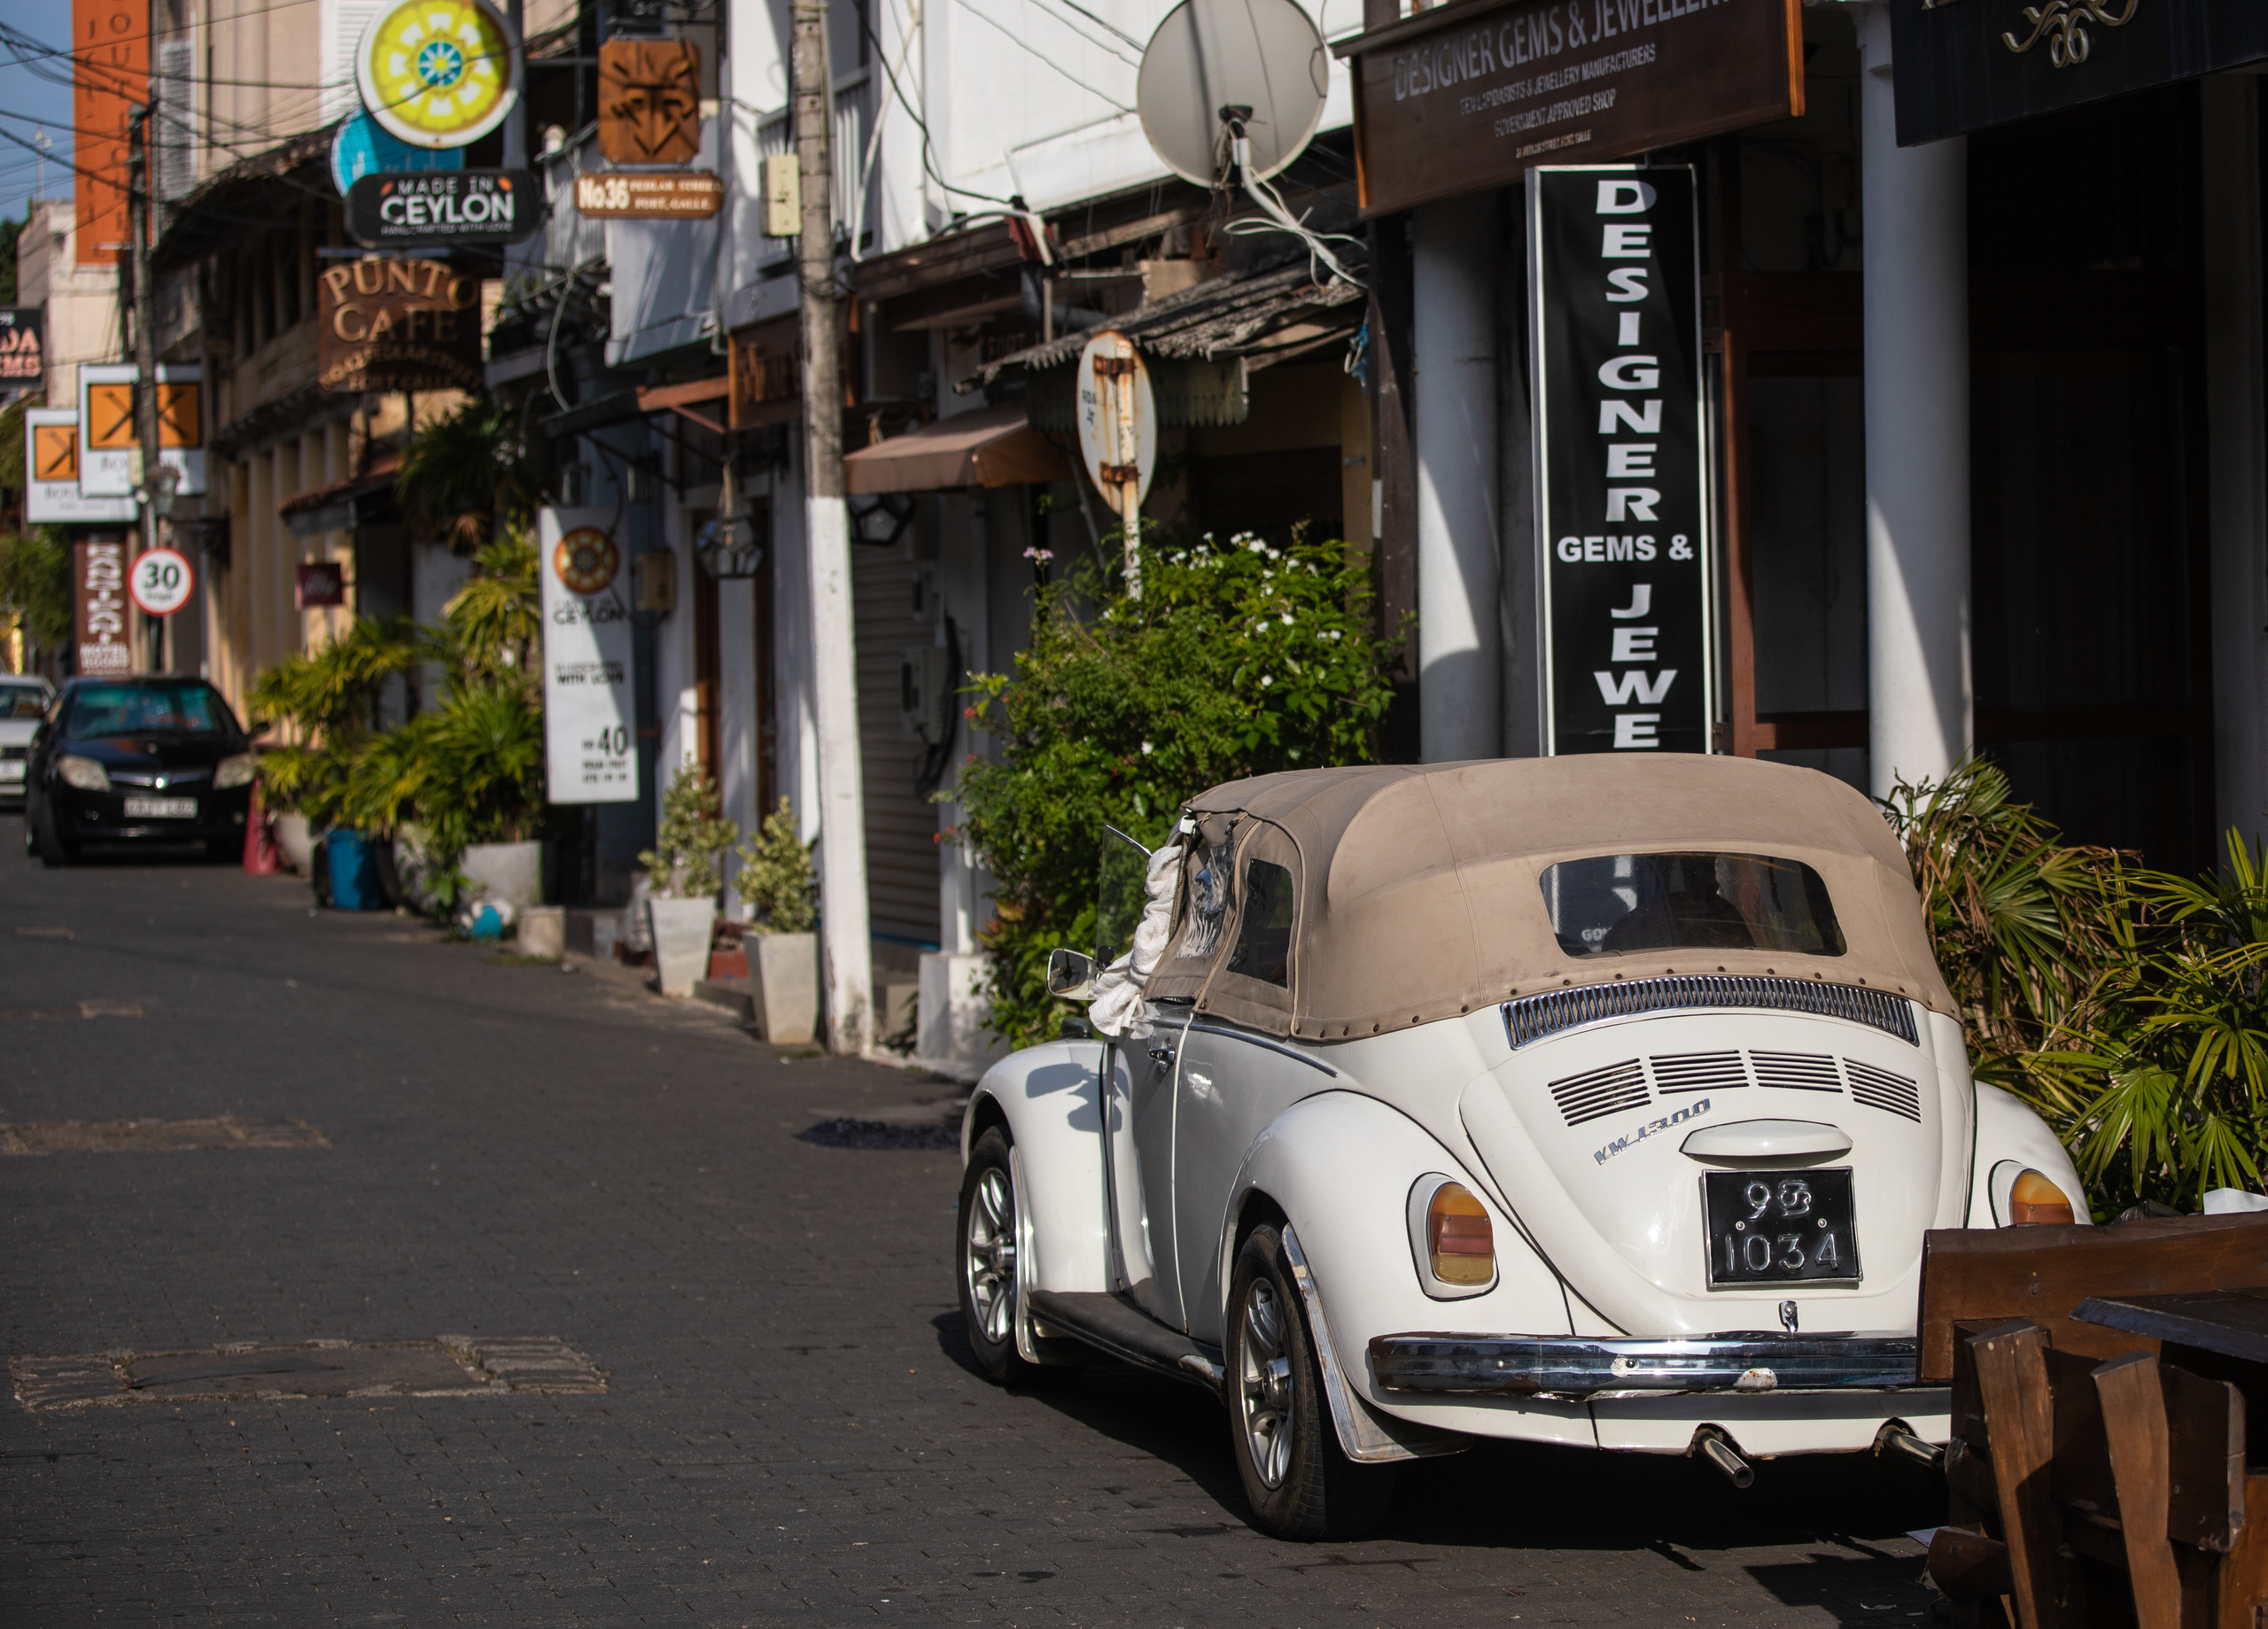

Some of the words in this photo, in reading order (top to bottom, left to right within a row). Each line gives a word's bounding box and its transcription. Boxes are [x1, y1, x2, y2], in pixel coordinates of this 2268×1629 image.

[1394, 28, 1495, 101] DESIGNER
[1499, 6, 1563, 68] GEMS
[1568, 0, 1587, 49] &
[1534, 65, 1580, 95] JEWELLERY
[1581, 43, 1656, 81] MANUFACTURERS
[1495, 107, 1546, 137] GOVERNMENT
[1547, 94, 1591, 123] APPROVED
[1592, 88, 1616, 112] SHOP
[398, 178, 459, 196] MADE
[470, 176, 493, 193] IN
[380, 191, 516, 224] CEYLON
[321, 259, 479, 308] PUNTO
[333, 302, 461, 342] CAFE
[1596, 180, 1663, 522] DESIGNER
[1557, 535, 1657, 562] GEMS
[1668, 534, 1694, 560] &
[144, 562, 179, 589] 30
[554, 607, 625, 624] CEYLON
[598, 726, 627, 756] 40
[1638, 1098, 1712, 1142] 1300
[1745, 1181, 1771, 1220] 9
[1725, 1232, 1844, 1273] 1034
